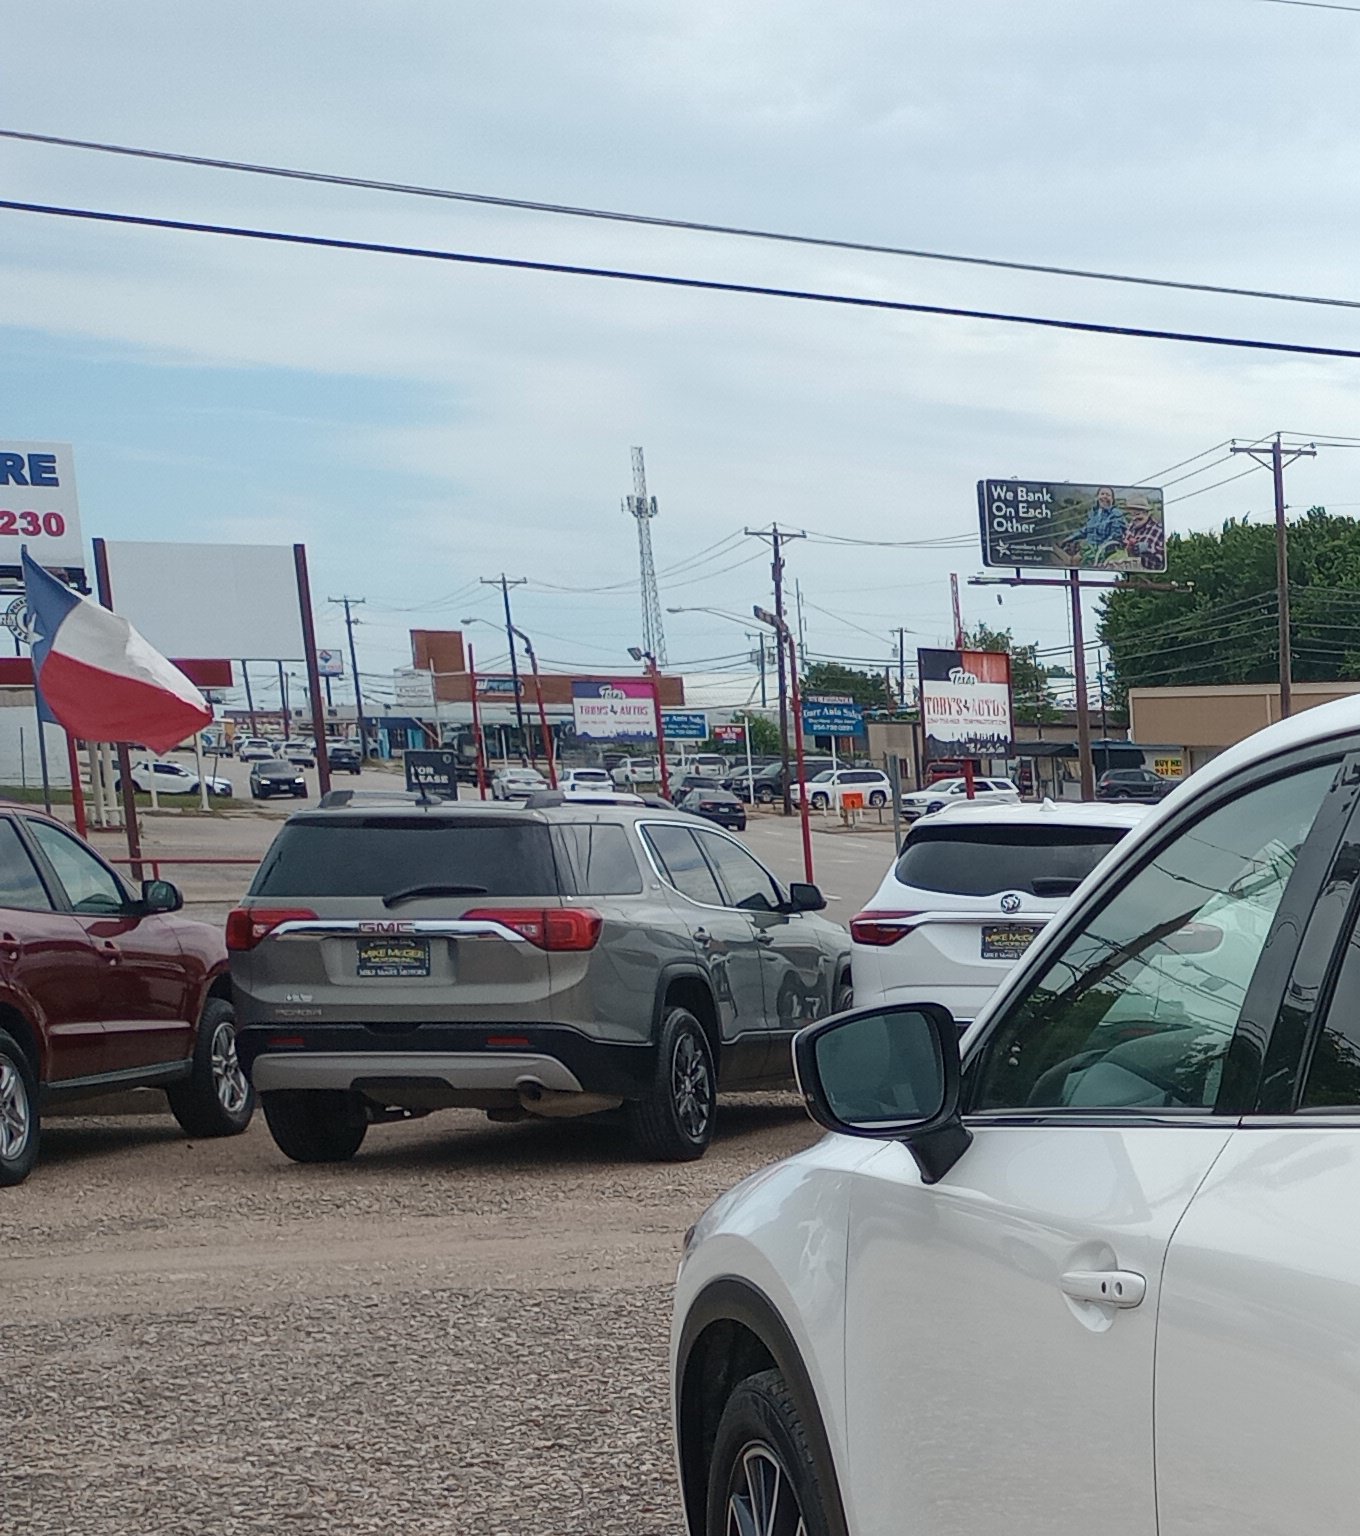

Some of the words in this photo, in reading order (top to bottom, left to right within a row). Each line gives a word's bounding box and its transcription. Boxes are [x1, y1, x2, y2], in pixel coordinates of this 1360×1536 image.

[991, 484, 1014, 501] We
[1017, 485, 1053, 503] Bank
[992, 501, 1015, 517] On
[1018, 502, 1052, 519] Each
[993, 517, 1036, 534] Other
[359, 922, 416, 934] GMC
